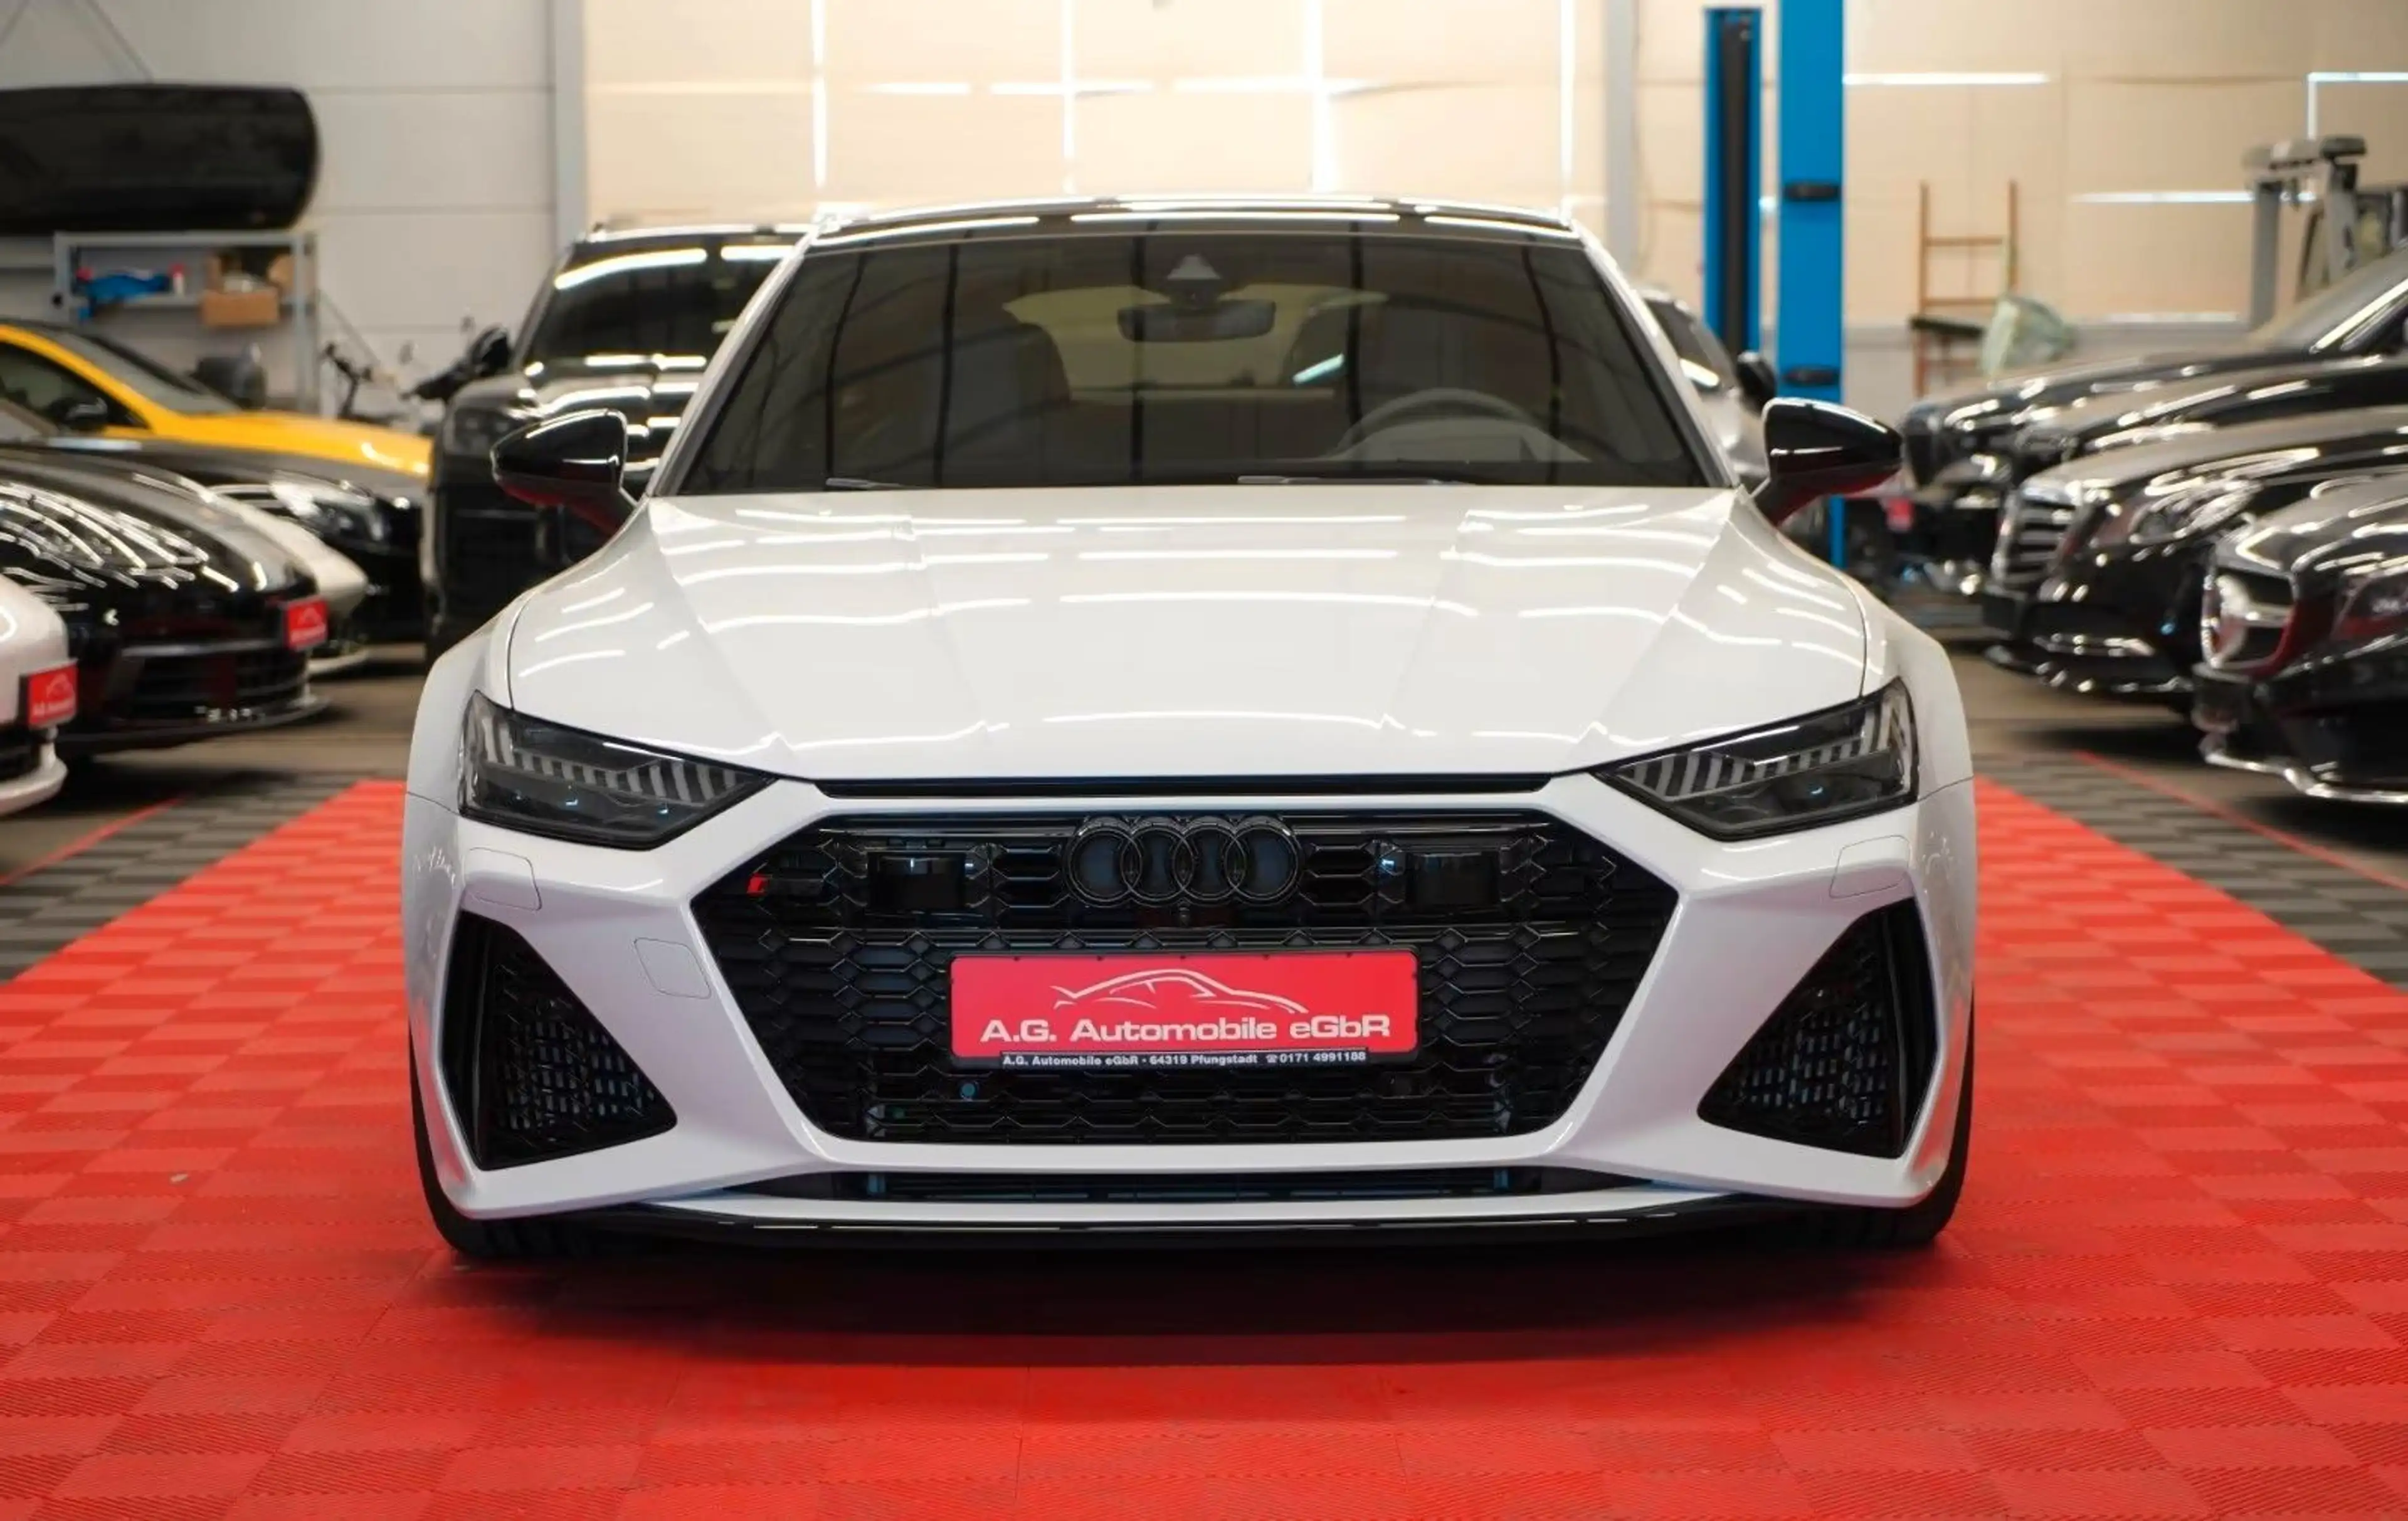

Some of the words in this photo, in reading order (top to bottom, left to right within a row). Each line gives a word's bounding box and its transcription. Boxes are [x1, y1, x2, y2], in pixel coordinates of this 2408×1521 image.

[980, 1019, 1057, 1042] A.G.
[1070, 1017, 1277, 1041] Automobile
[1290, 1015, 1390, 1039] eGbR
[1003, 1056, 1028, 1065] A.G.
[1032, 1055, 1101, 1065] Automobile
[1105, 1055, 1138, 1065] eGbR
[1191, 1054, 1257, 1066] Pfungstadt
